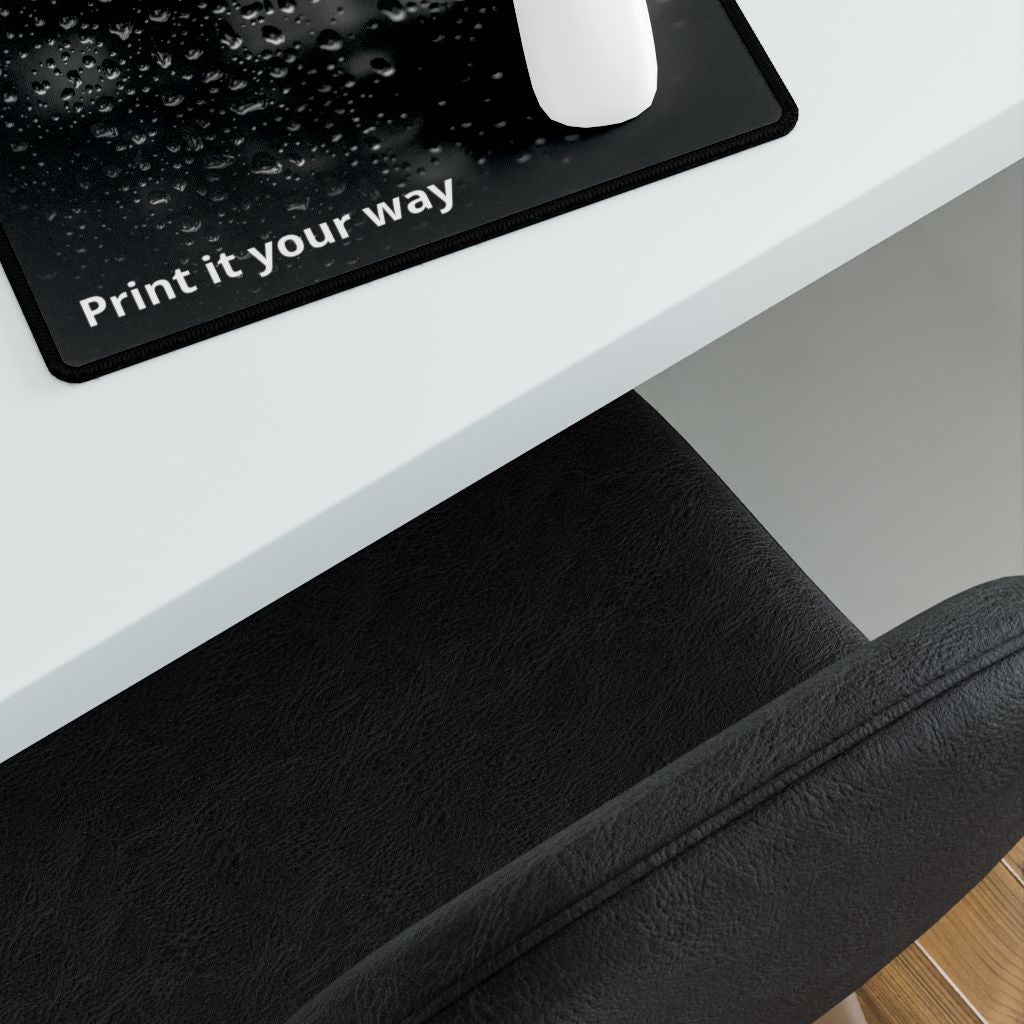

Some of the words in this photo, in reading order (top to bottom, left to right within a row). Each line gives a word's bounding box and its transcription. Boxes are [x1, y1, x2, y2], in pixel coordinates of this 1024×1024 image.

[80, 269, 197, 327] Print
[202, 253, 242, 284] it
[248, 214, 350, 277] your
[363, 179, 452, 226] way
